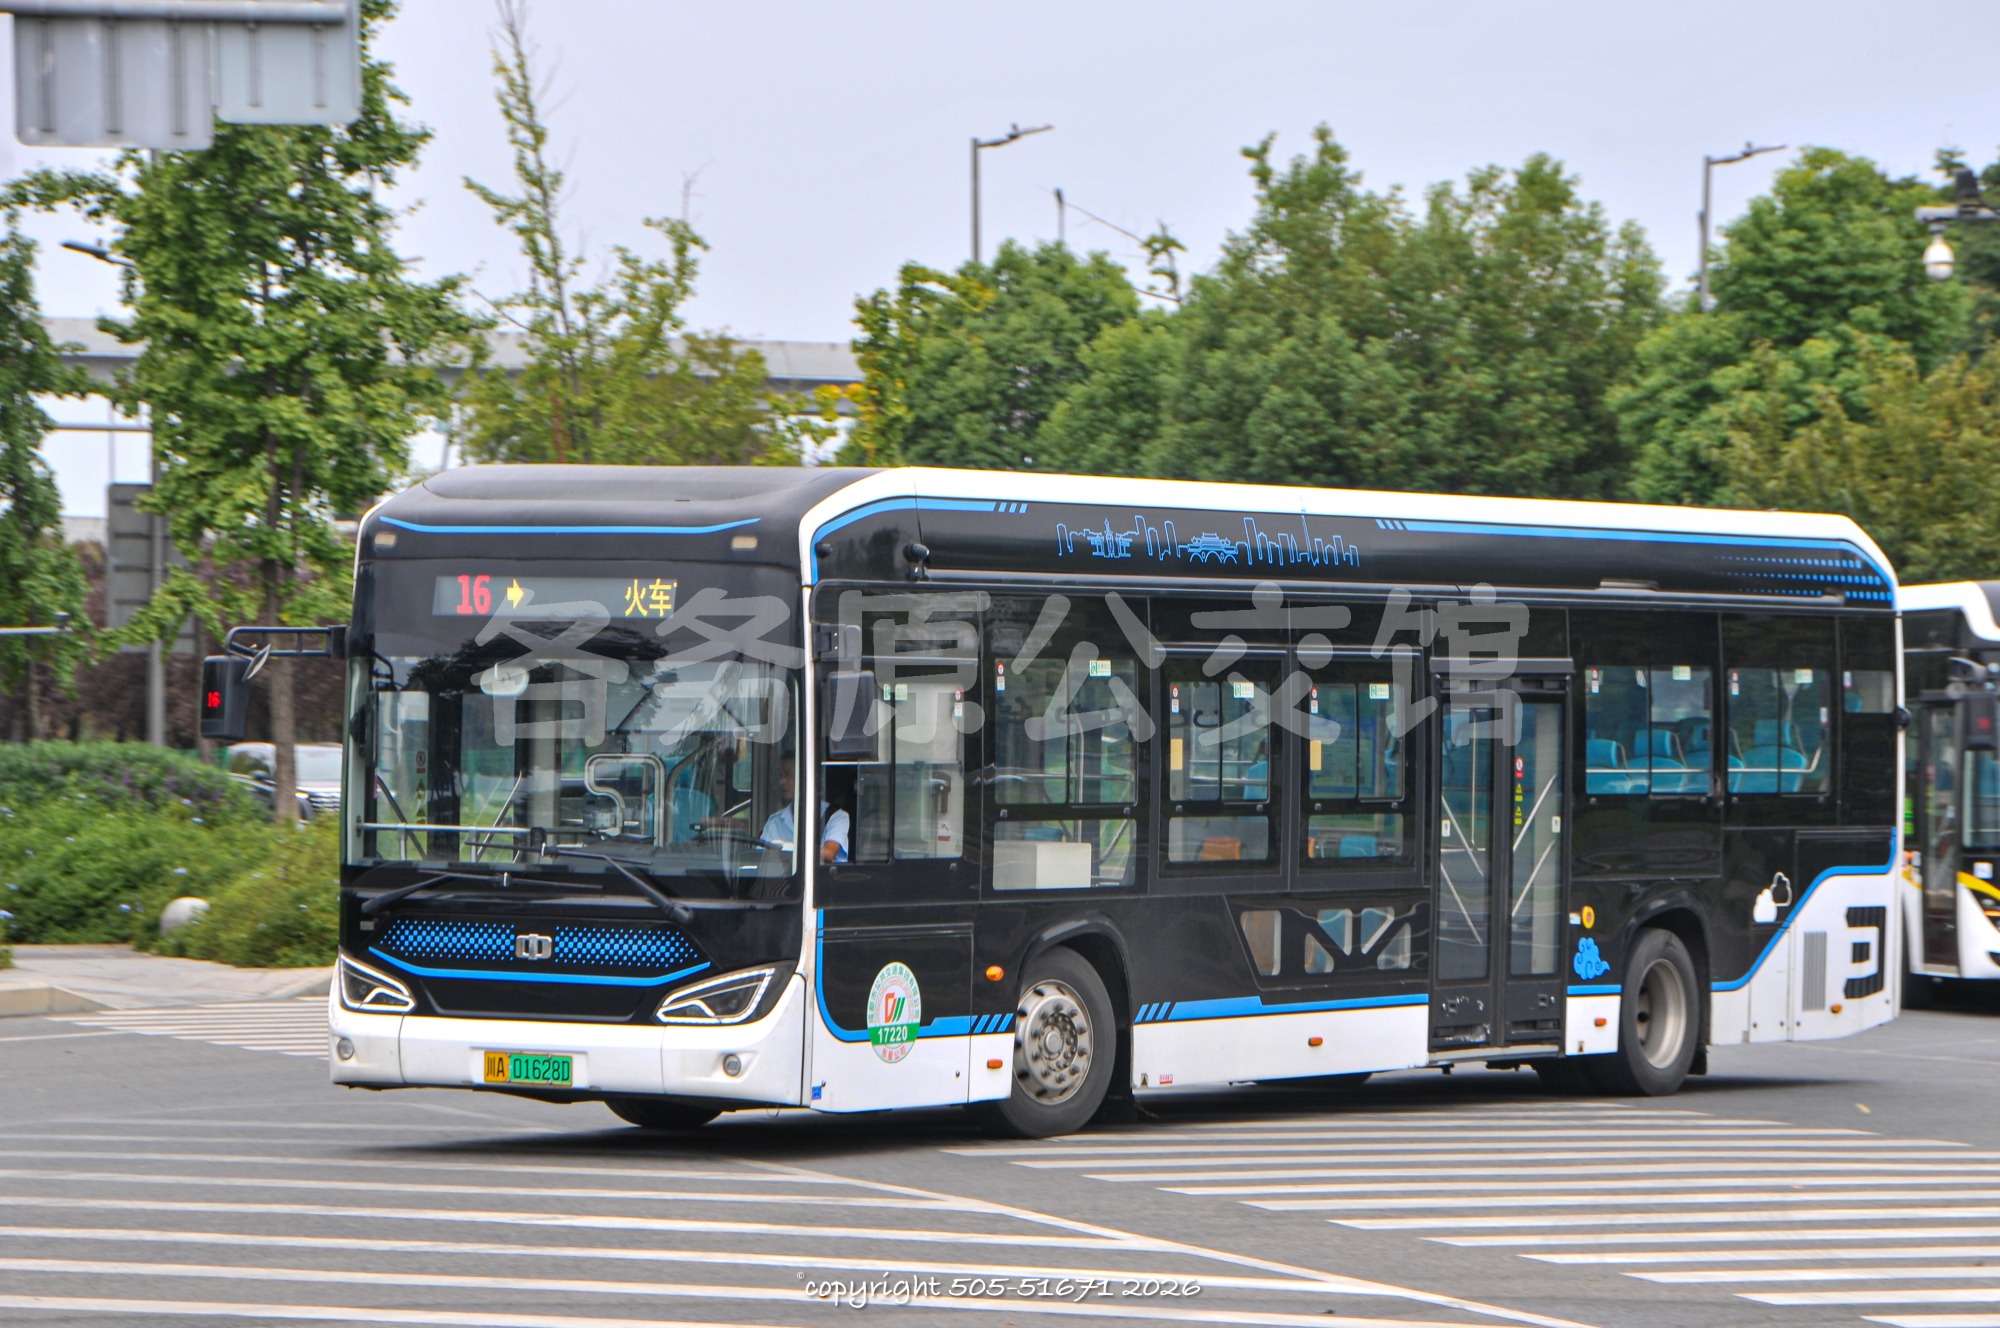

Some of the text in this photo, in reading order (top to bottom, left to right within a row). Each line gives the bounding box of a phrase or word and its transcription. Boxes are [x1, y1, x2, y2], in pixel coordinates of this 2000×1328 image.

[456, 574, 678, 617] 16 火车
[207, 691, 221, 708] 16
[877, 1026, 908, 1044] 17220
